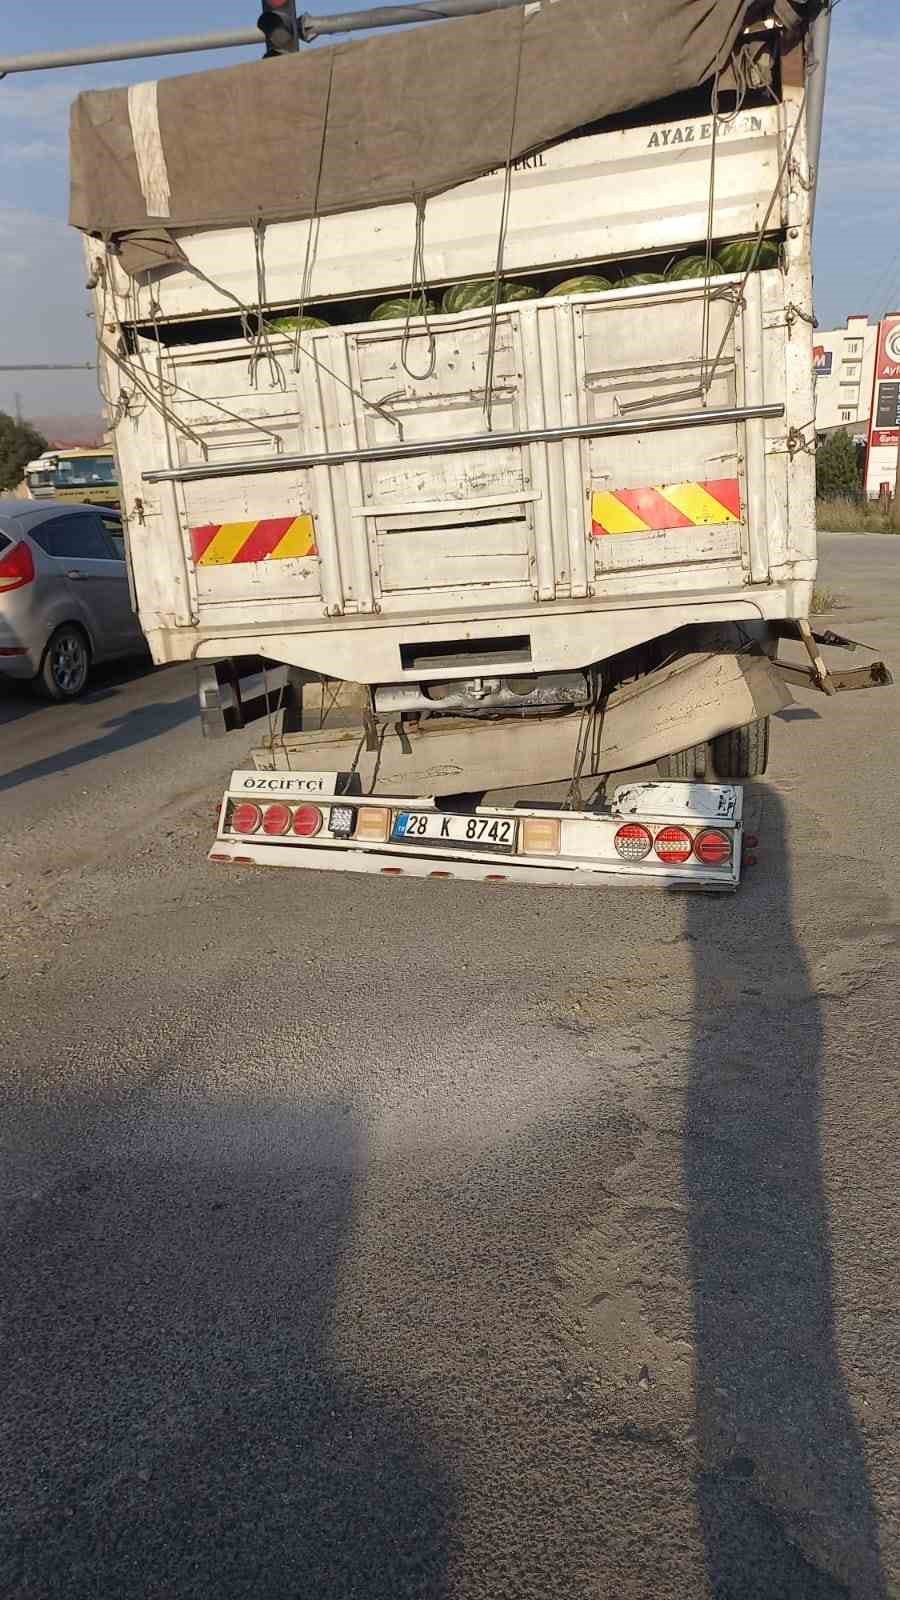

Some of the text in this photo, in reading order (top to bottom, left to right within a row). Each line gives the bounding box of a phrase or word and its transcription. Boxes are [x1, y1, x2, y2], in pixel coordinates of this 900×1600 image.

[647, 126, 695, 148] AYAZ
[406, 816, 428, 835] 28
[440, 817, 451, 837] K
[465, 818, 511, 842] 8742
